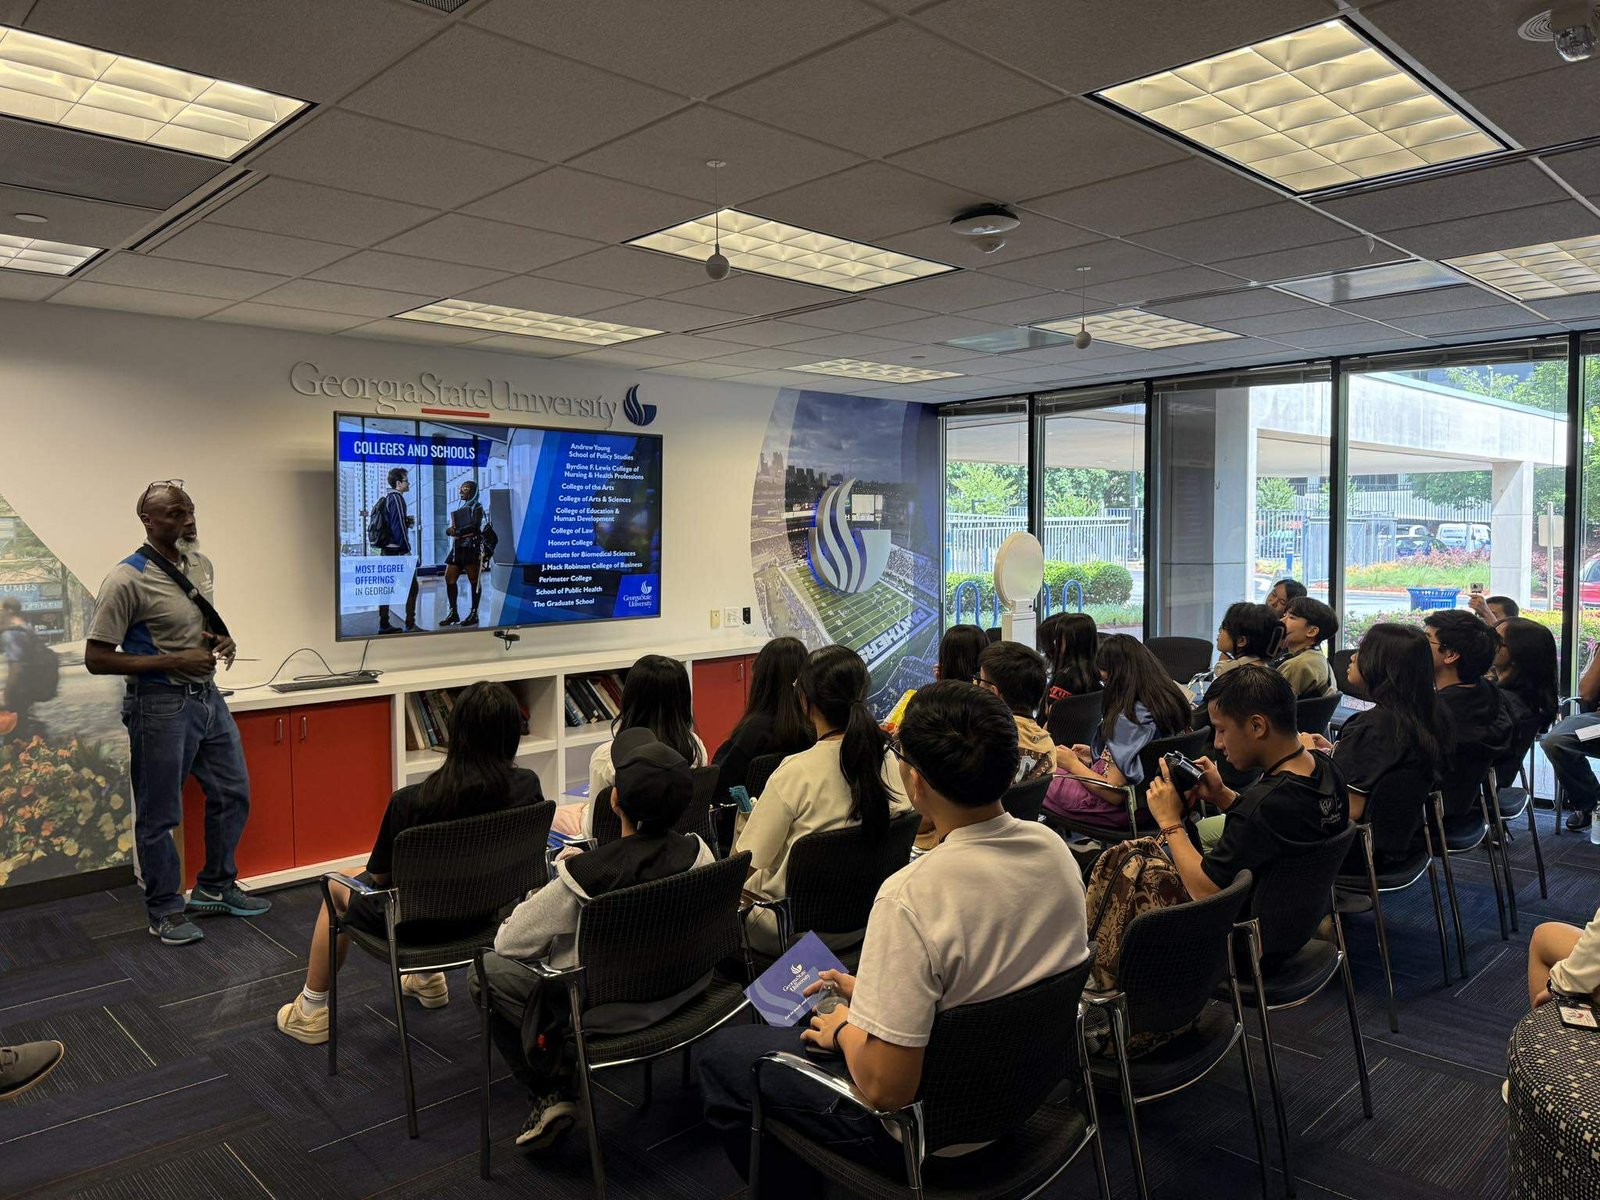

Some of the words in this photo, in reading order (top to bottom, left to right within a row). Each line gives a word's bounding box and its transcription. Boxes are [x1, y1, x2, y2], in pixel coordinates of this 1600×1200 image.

[354, 441, 405, 456] COLLEGES
[407, 444, 428, 457] AND
[430, 445, 475, 460] SCHOOLS
[593, 444, 611, 453] Young
[596, 452, 612, 461] Policy
[566, 463, 589, 471] Byrdine
[612, 465, 632, 474] College
[564, 471, 587, 479] Nursing
[561, 483, 583, 491] College
[558, 495, 580, 503] College
[555, 507, 578, 515] College
[577, 515, 615, 523] Development
[550, 527, 573, 535] College
[571, 539, 593, 547] College
[581, 550, 612, 558] Biomedical
[355, 565, 375, 574] MOST
[377, 564, 404, 573] DEGREE
[591, 562, 612, 570] College
[355, 576, 395, 585] OFFERINGS
[355, 588, 363, 596] IN
[364, 587, 395, 596] GEORGIA
